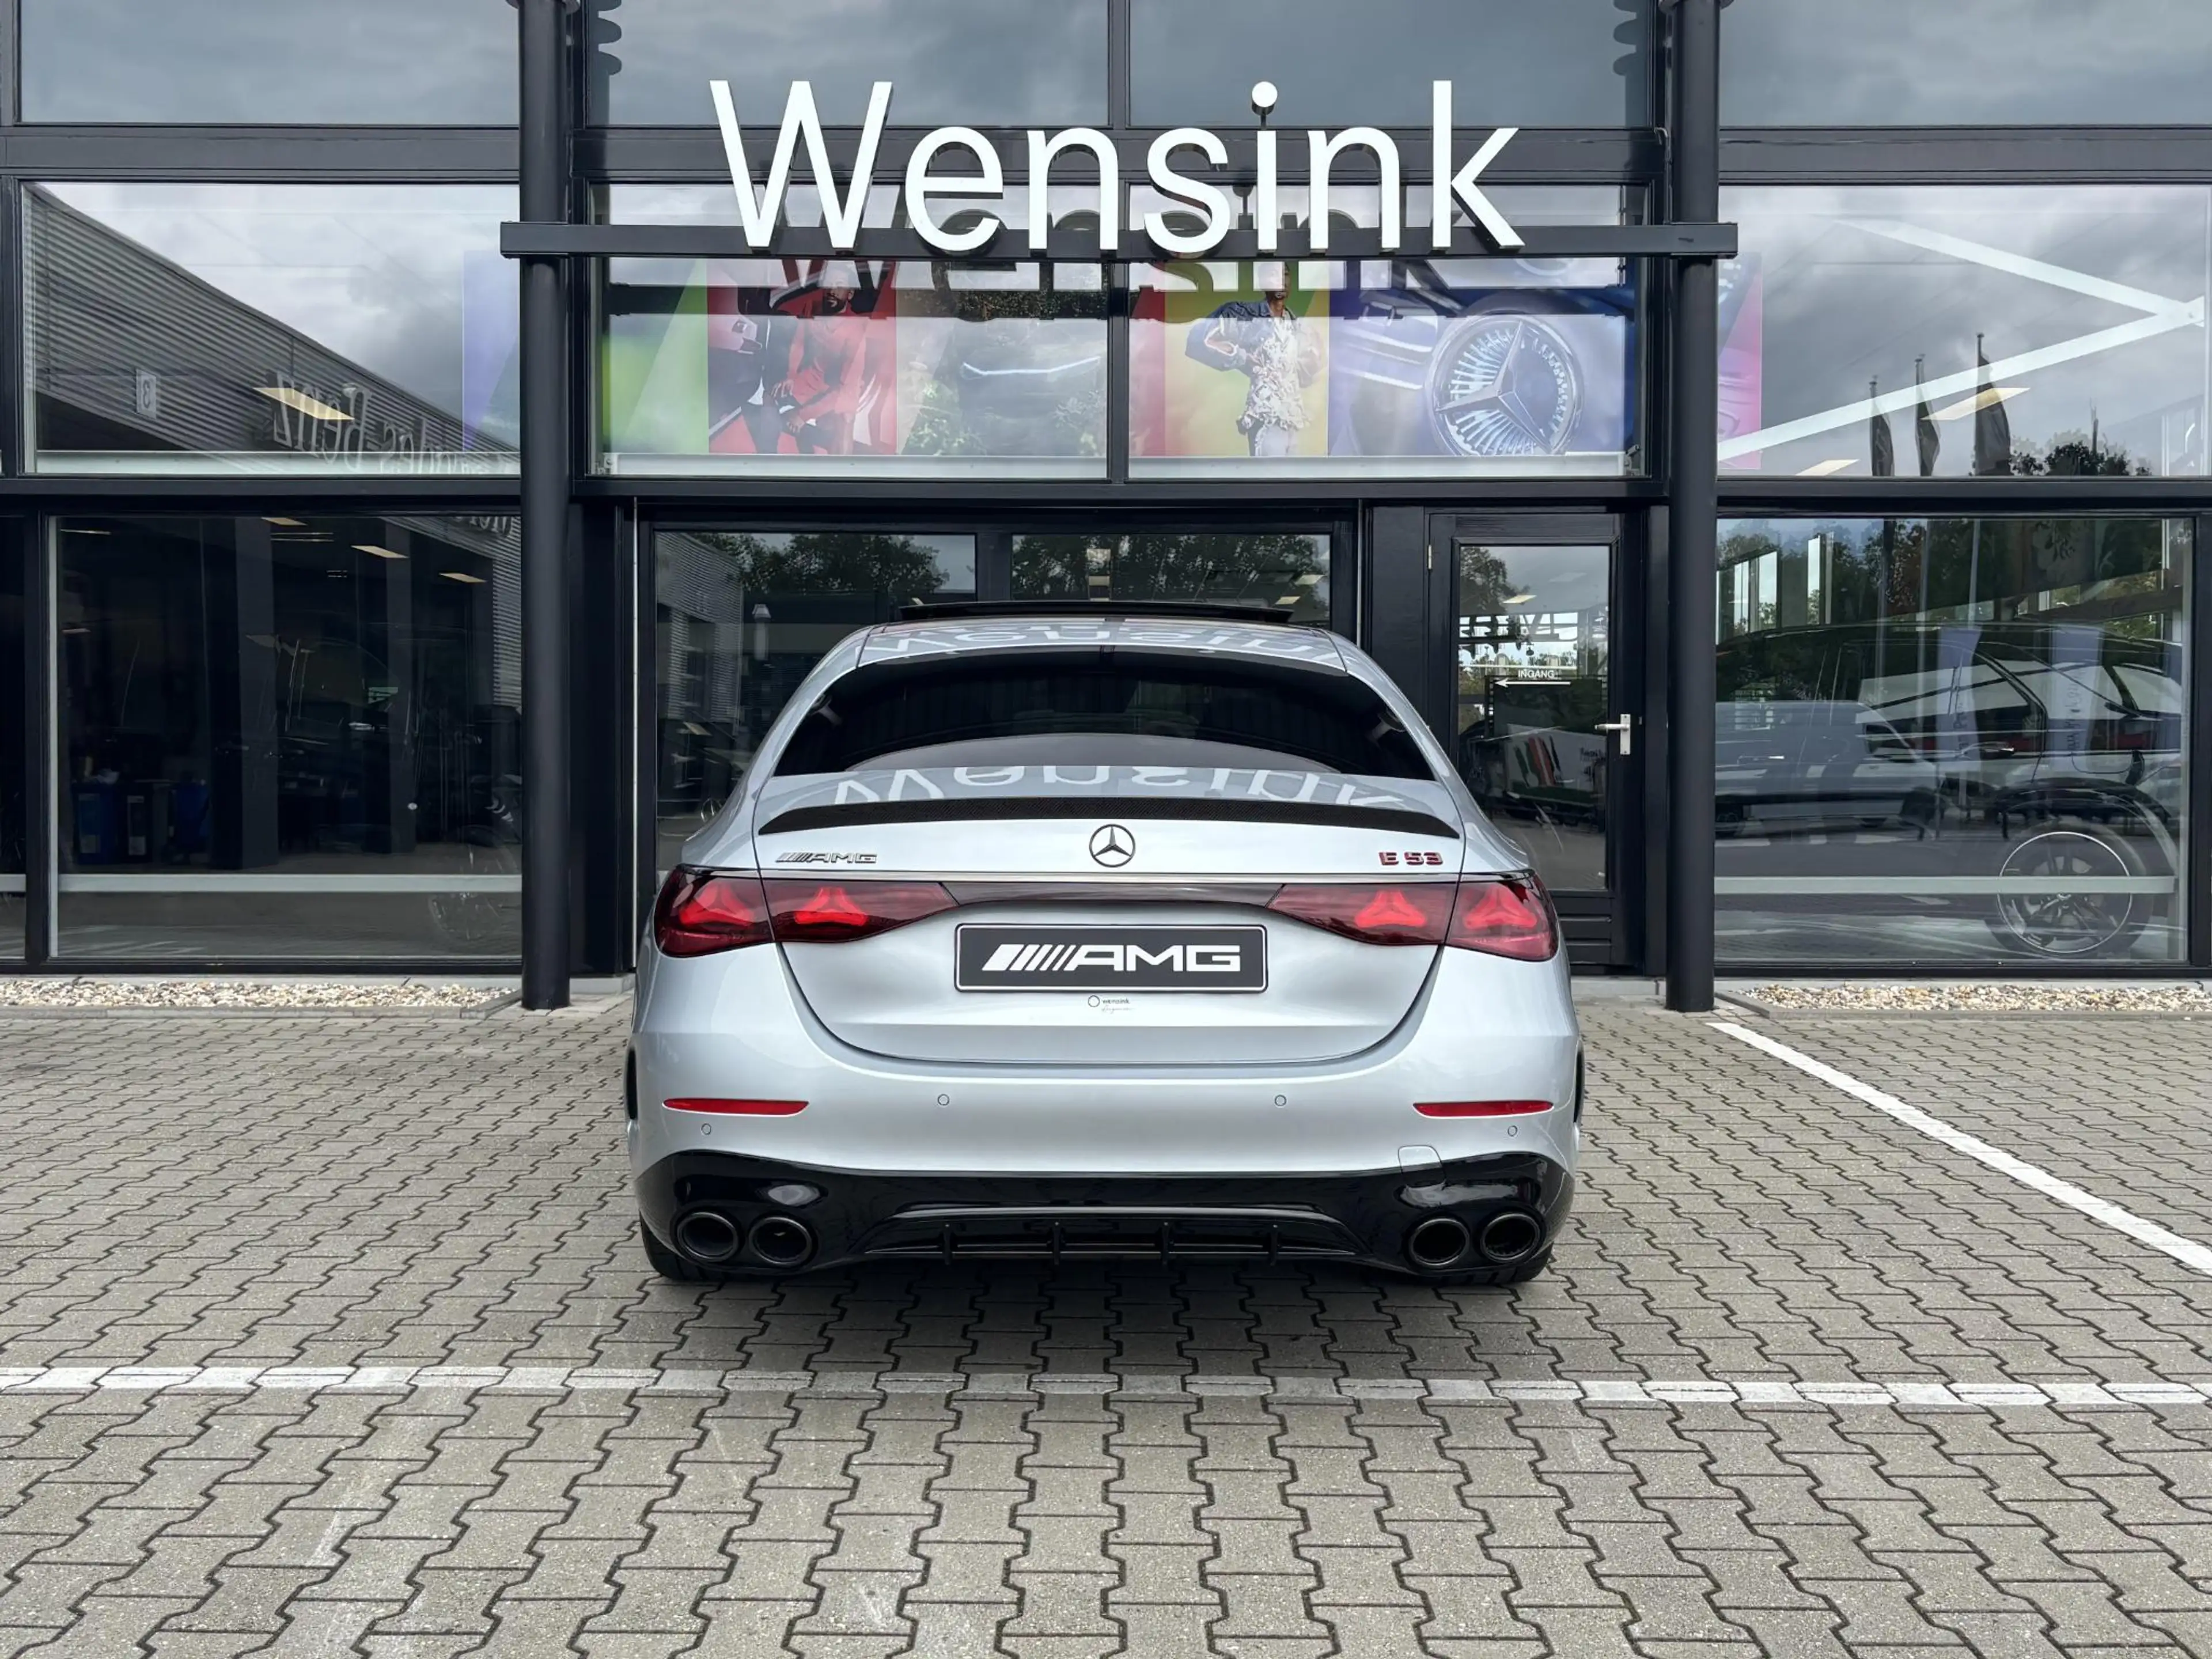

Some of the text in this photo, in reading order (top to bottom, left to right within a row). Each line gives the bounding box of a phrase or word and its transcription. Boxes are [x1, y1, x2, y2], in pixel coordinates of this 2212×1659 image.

[709, 79, 1526, 253] Wensink
[1517, 669, 1555, 679] INGANG
[1378, 852, 1443, 865] E 53
[1063, 944, 1241, 972] AMG
